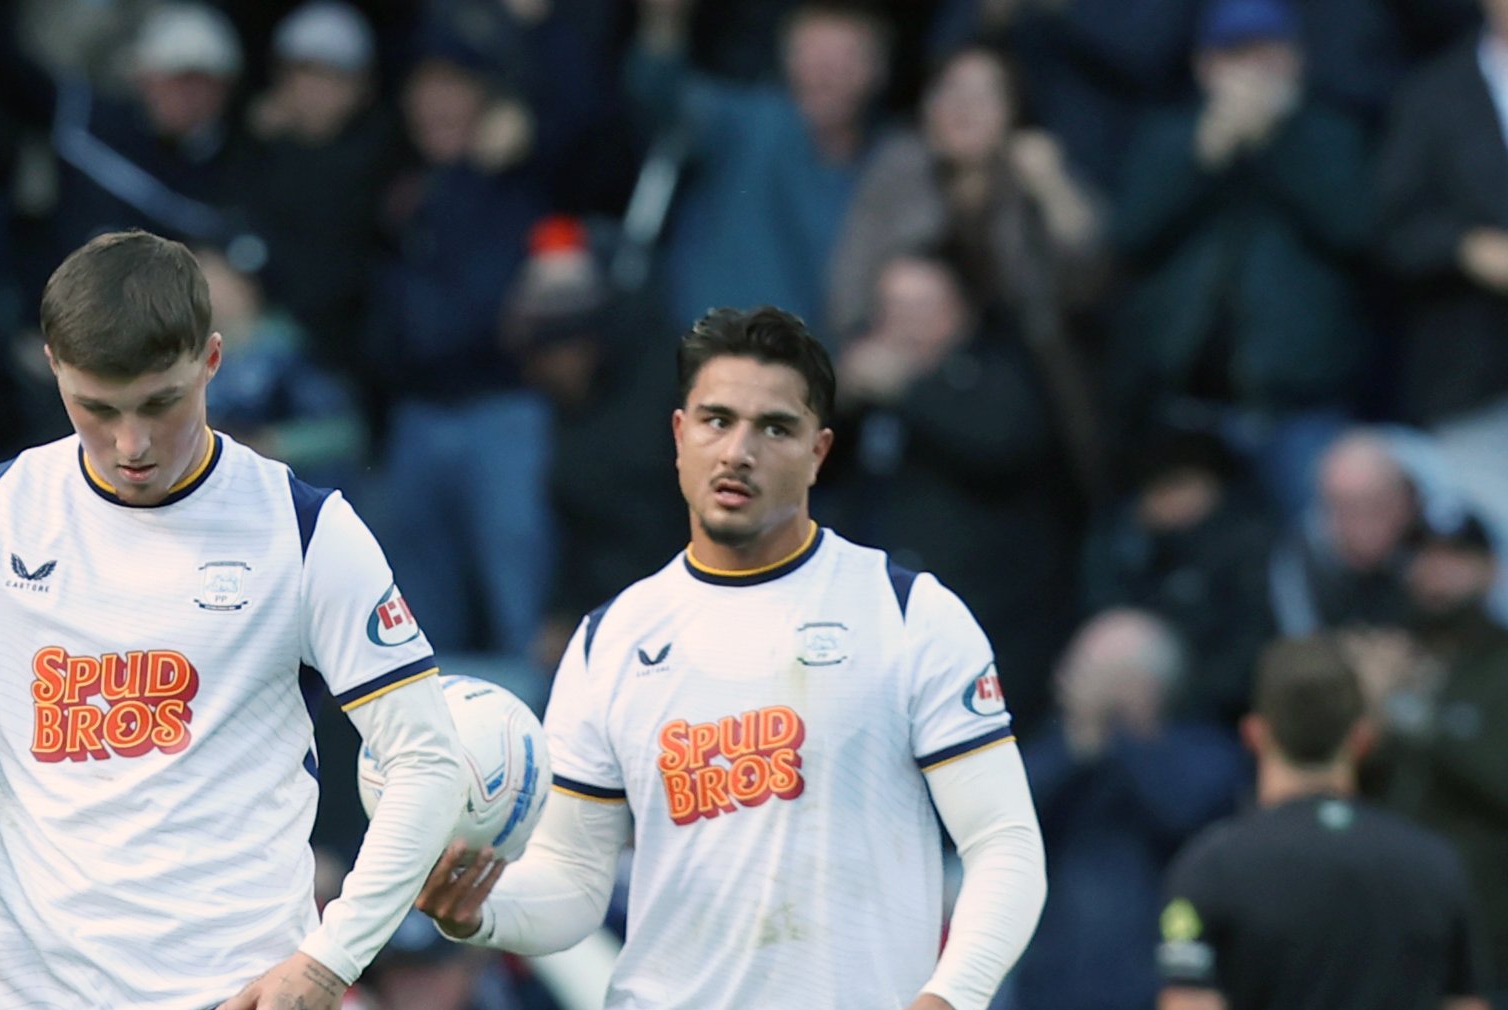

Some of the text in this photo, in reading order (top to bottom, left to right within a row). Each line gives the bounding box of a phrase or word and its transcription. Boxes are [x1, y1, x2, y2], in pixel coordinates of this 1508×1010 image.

[31, 645, 199, 705] SPUD
[30, 700, 193, 763] BROS
[658, 705, 806, 774] SPUD
[663, 748, 805, 826] BROS
